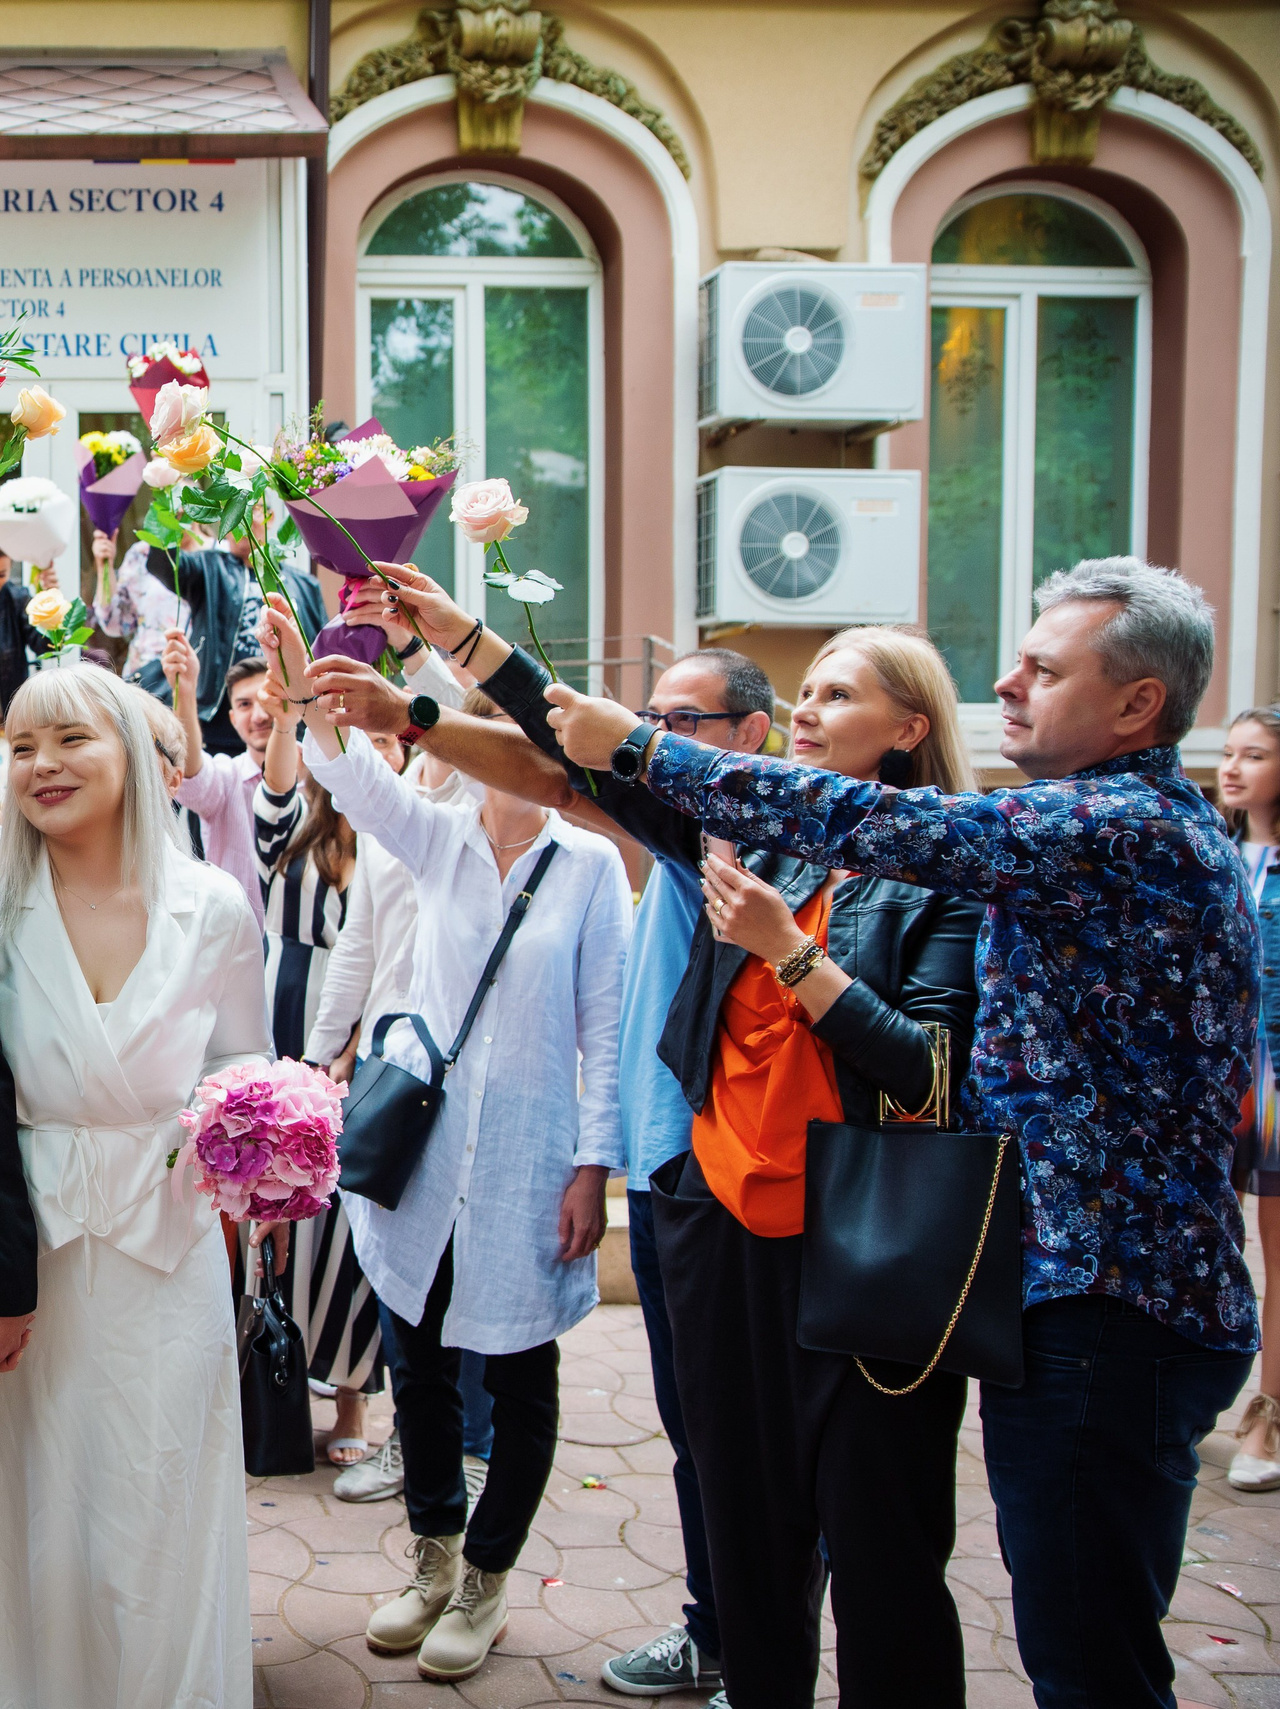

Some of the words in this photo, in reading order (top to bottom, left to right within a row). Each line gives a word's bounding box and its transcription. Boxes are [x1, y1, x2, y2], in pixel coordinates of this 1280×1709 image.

[68, 187, 199, 213] SECTOR
[209, 190, 225, 212] 4
[59, 267, 73, 288] A
[78, 267, 223, 289] PERSOANELOR
[55, 300, 66, 318] 4
[21, 331, 112, 357] STARE
